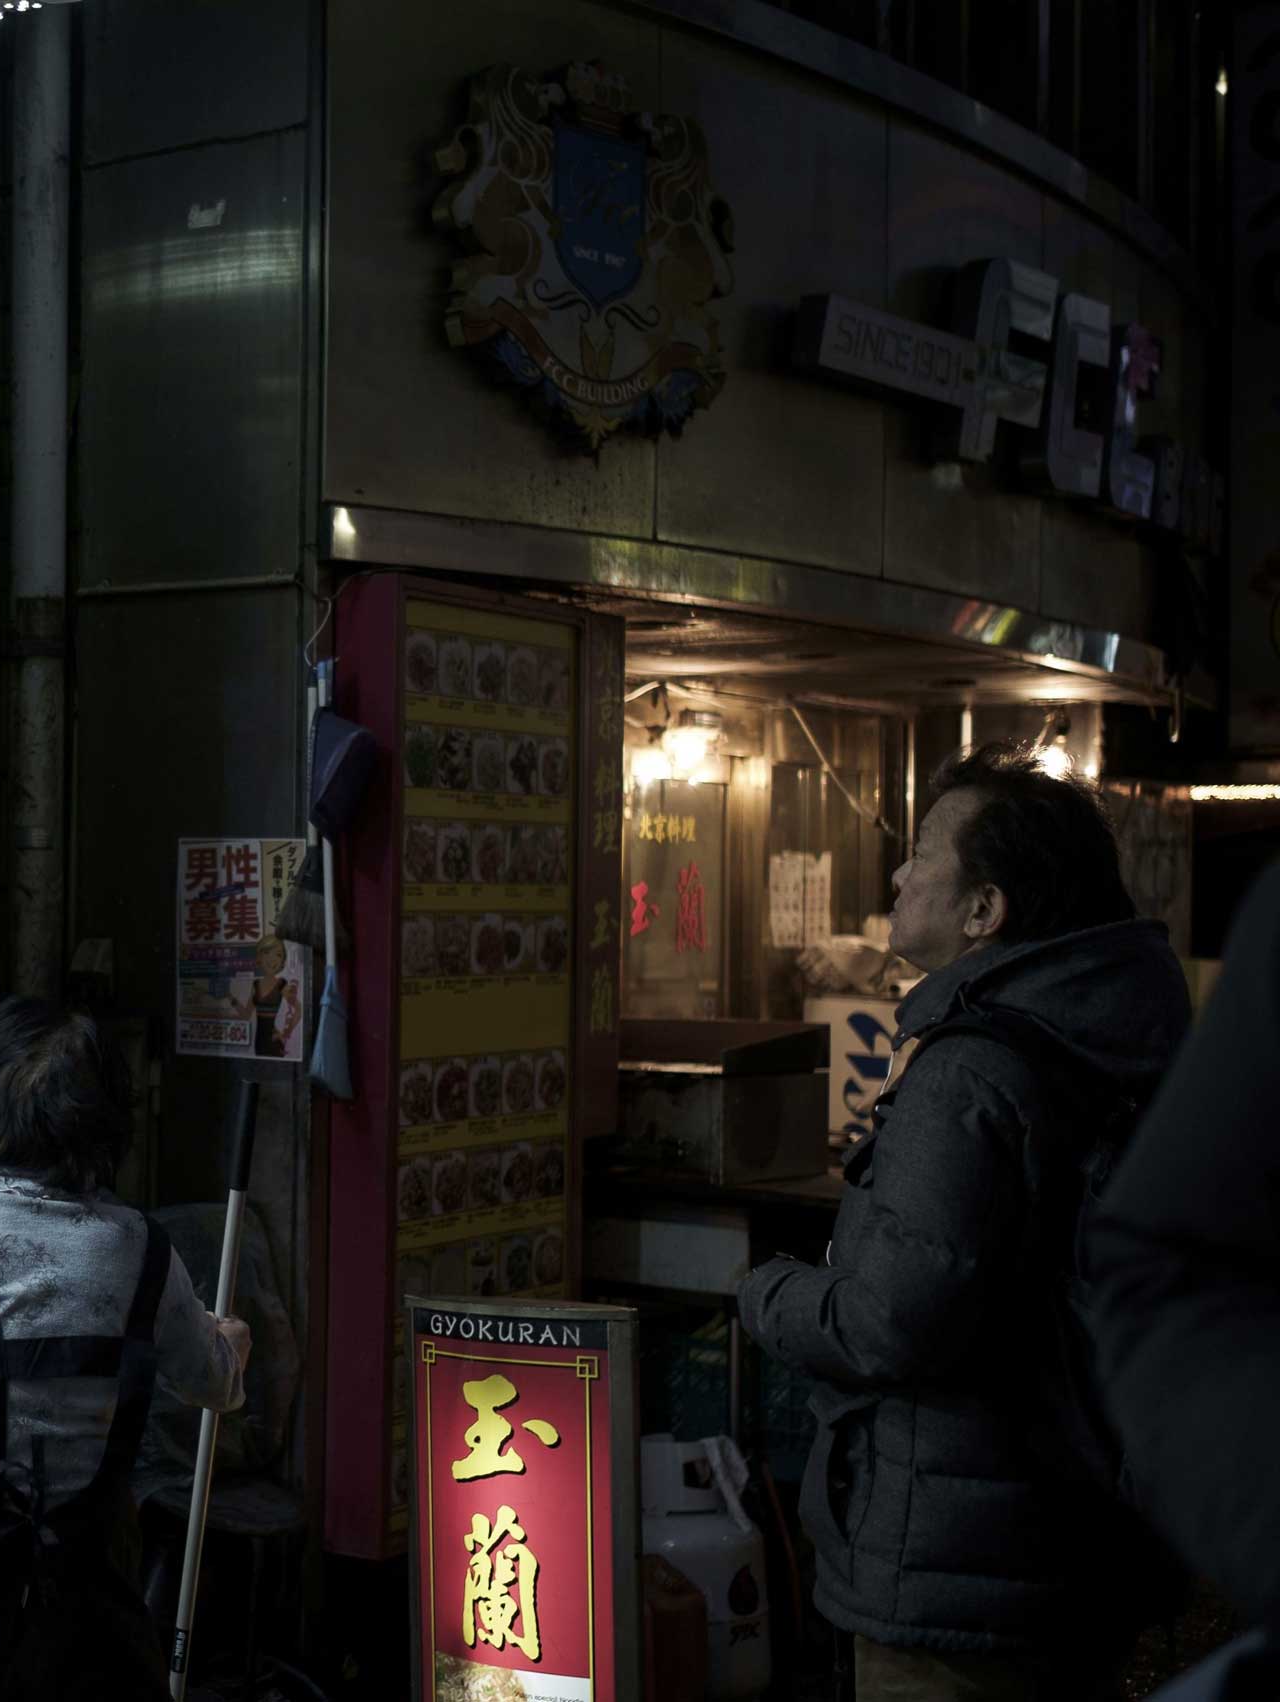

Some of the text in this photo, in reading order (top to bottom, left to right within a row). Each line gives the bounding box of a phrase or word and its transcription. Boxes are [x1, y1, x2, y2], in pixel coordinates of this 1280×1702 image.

[577, 375, 649, 403] BUILDING
[186, 845, 259, 891] 男性
[185, 895, 260, 940] 募集
[431, 1314, 580, 1347] GYOKURAN
[452, 1374, 561, 1662] 玉蘭
